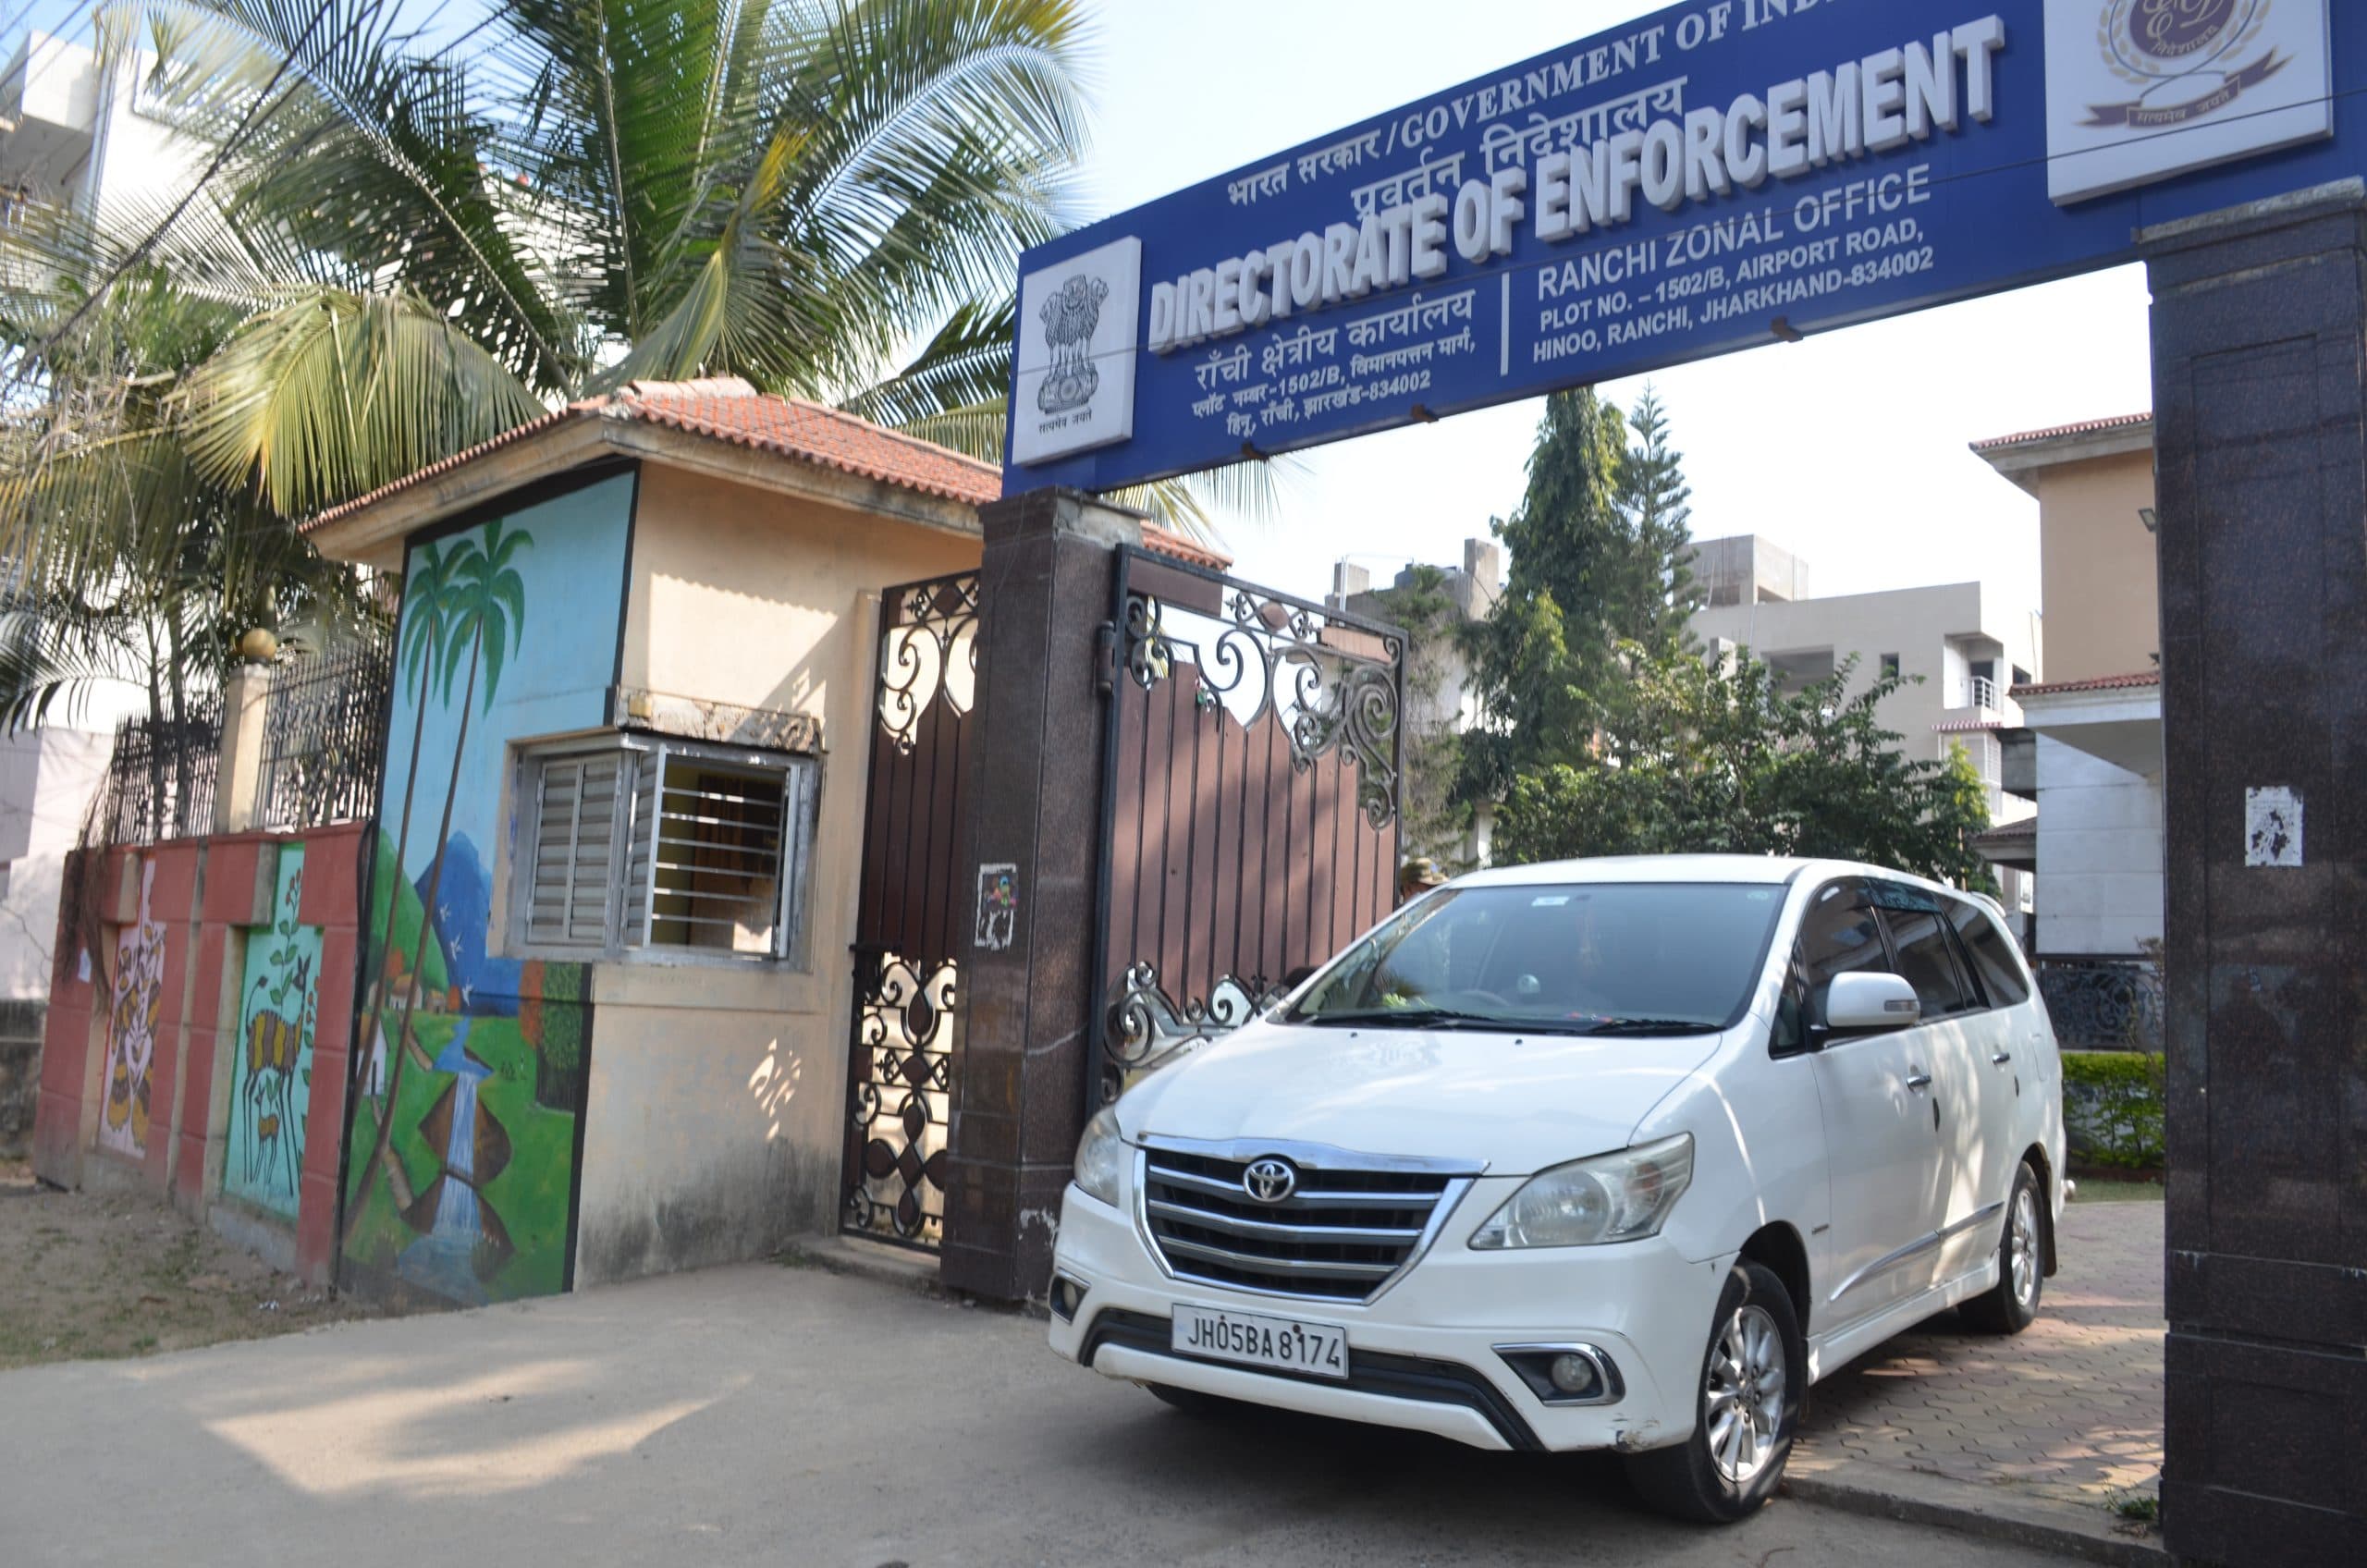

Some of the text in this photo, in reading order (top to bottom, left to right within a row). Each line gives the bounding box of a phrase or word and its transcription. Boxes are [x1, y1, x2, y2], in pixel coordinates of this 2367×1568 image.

[1228, 163, 1290, 206] भारत
[1297, 129, 1381, 184] सरकार
[1676, 1, 1731, 50] OF
[1351, 75, 1687, 221] प्रवर्तन निदेशालय
[1148, 14, 2005, 355] DIRECTORATE OF ENFORCEMENT
[1539, 164, 1931, 301] RANCHI ZONAL OFFICE
[1195, 288, 1476, 390] राँची क्षेत्रीय कार्यालय
[1533, 246, 1934, 362] HINOO, RANCHI, JHARKHAND-834002
[1540, 300, 1592, 332] PLOT
[1597, 292, 1632, 317] NO.
[1735, 237, 1839, 281] AIRPORT
[1846, 218, 1923, 256] ROAD,
